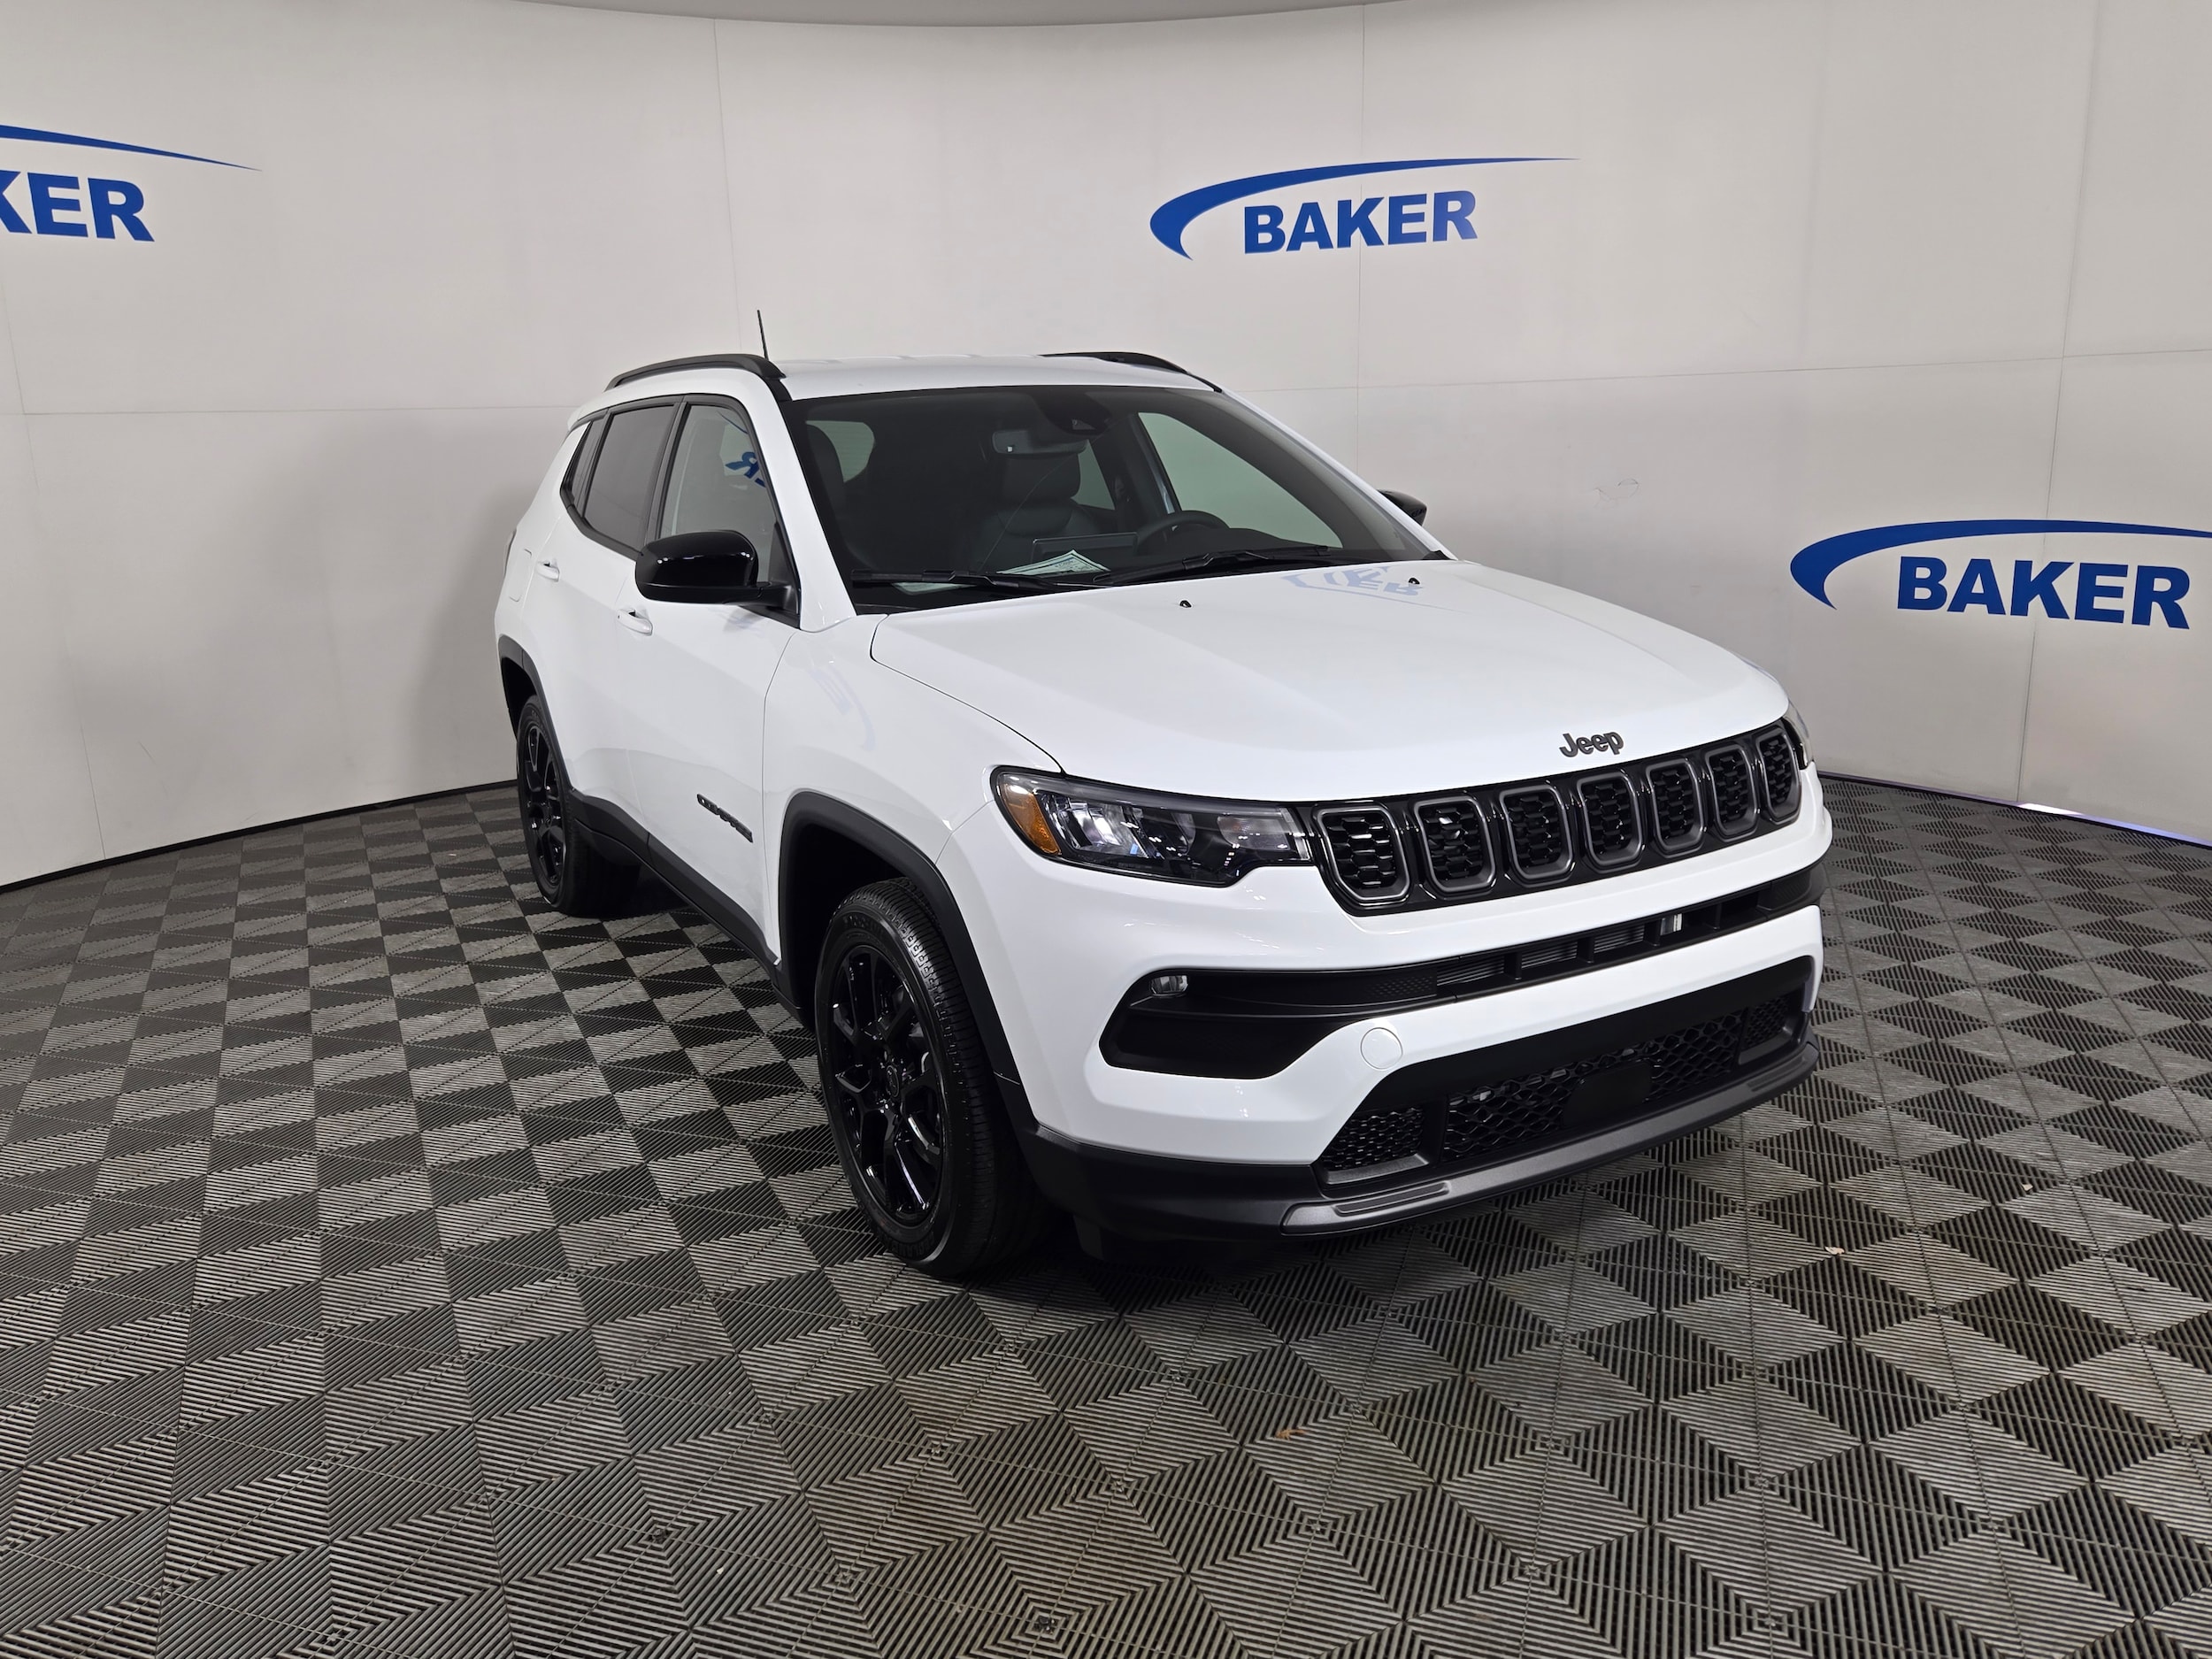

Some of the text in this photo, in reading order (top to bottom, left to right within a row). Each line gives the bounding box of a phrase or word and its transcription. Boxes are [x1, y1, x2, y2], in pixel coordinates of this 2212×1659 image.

[1244, 190, 1478, 254] BAKER
[1897, 556, 2191, 629] BAKER
[1559, 731, 1624, 758] Jeep
